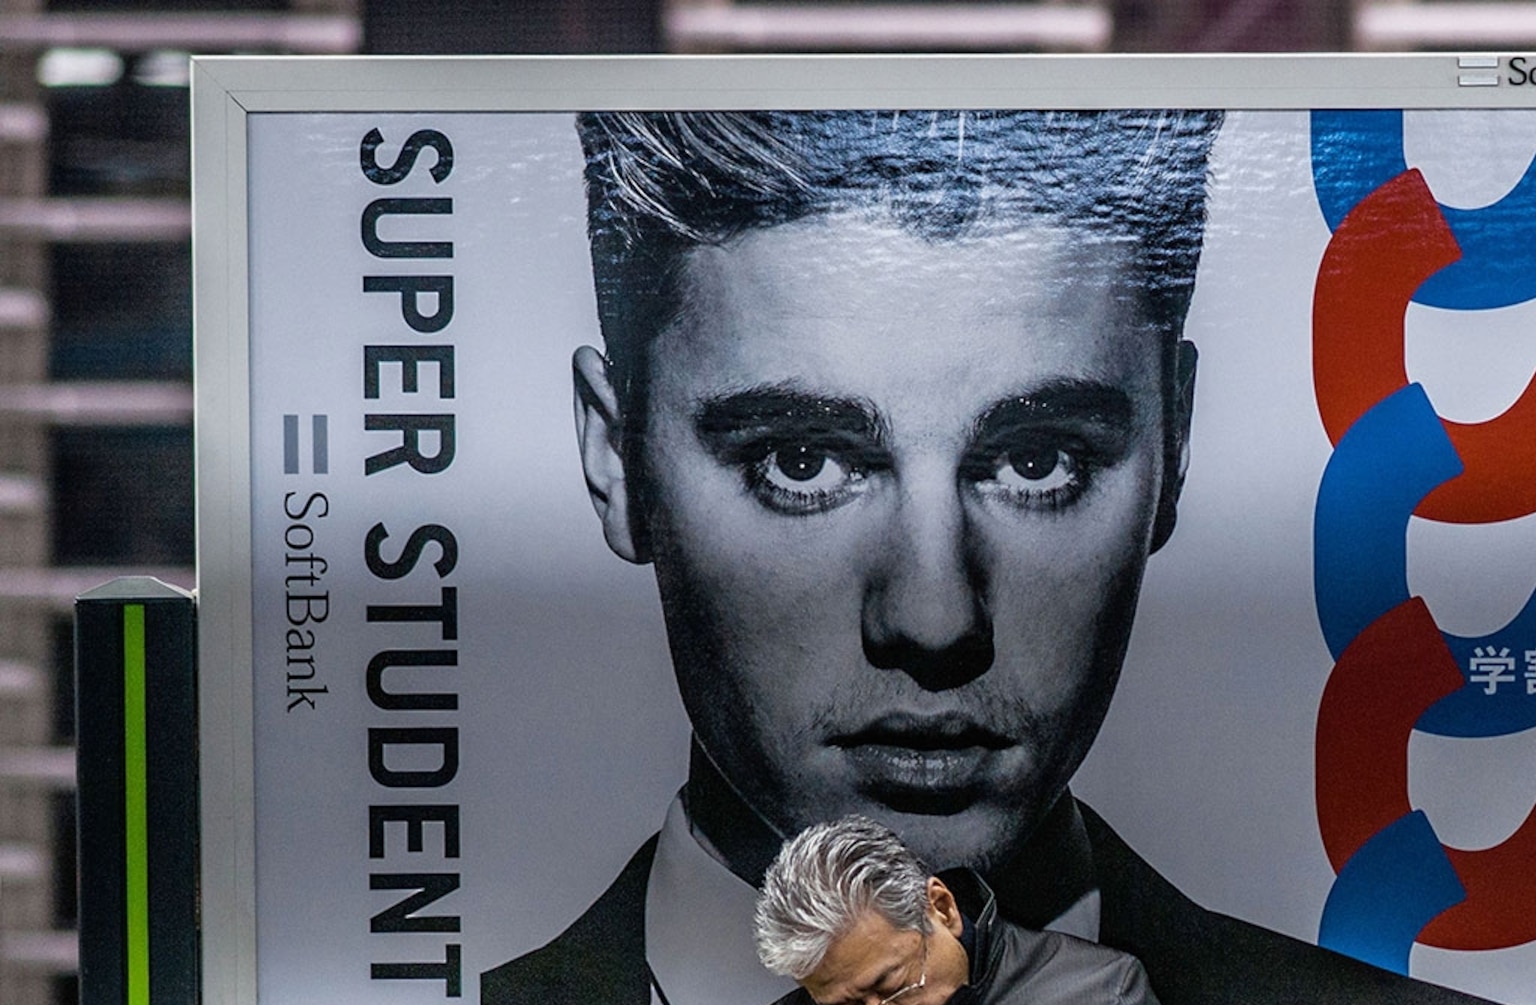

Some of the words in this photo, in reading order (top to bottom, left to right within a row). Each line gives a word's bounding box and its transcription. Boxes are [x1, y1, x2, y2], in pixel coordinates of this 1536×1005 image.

[359, 127, 457, 478] SUPER
[283, 491, 331, 714] SoftBank
[364, 521, 463, 999] STUDENT
